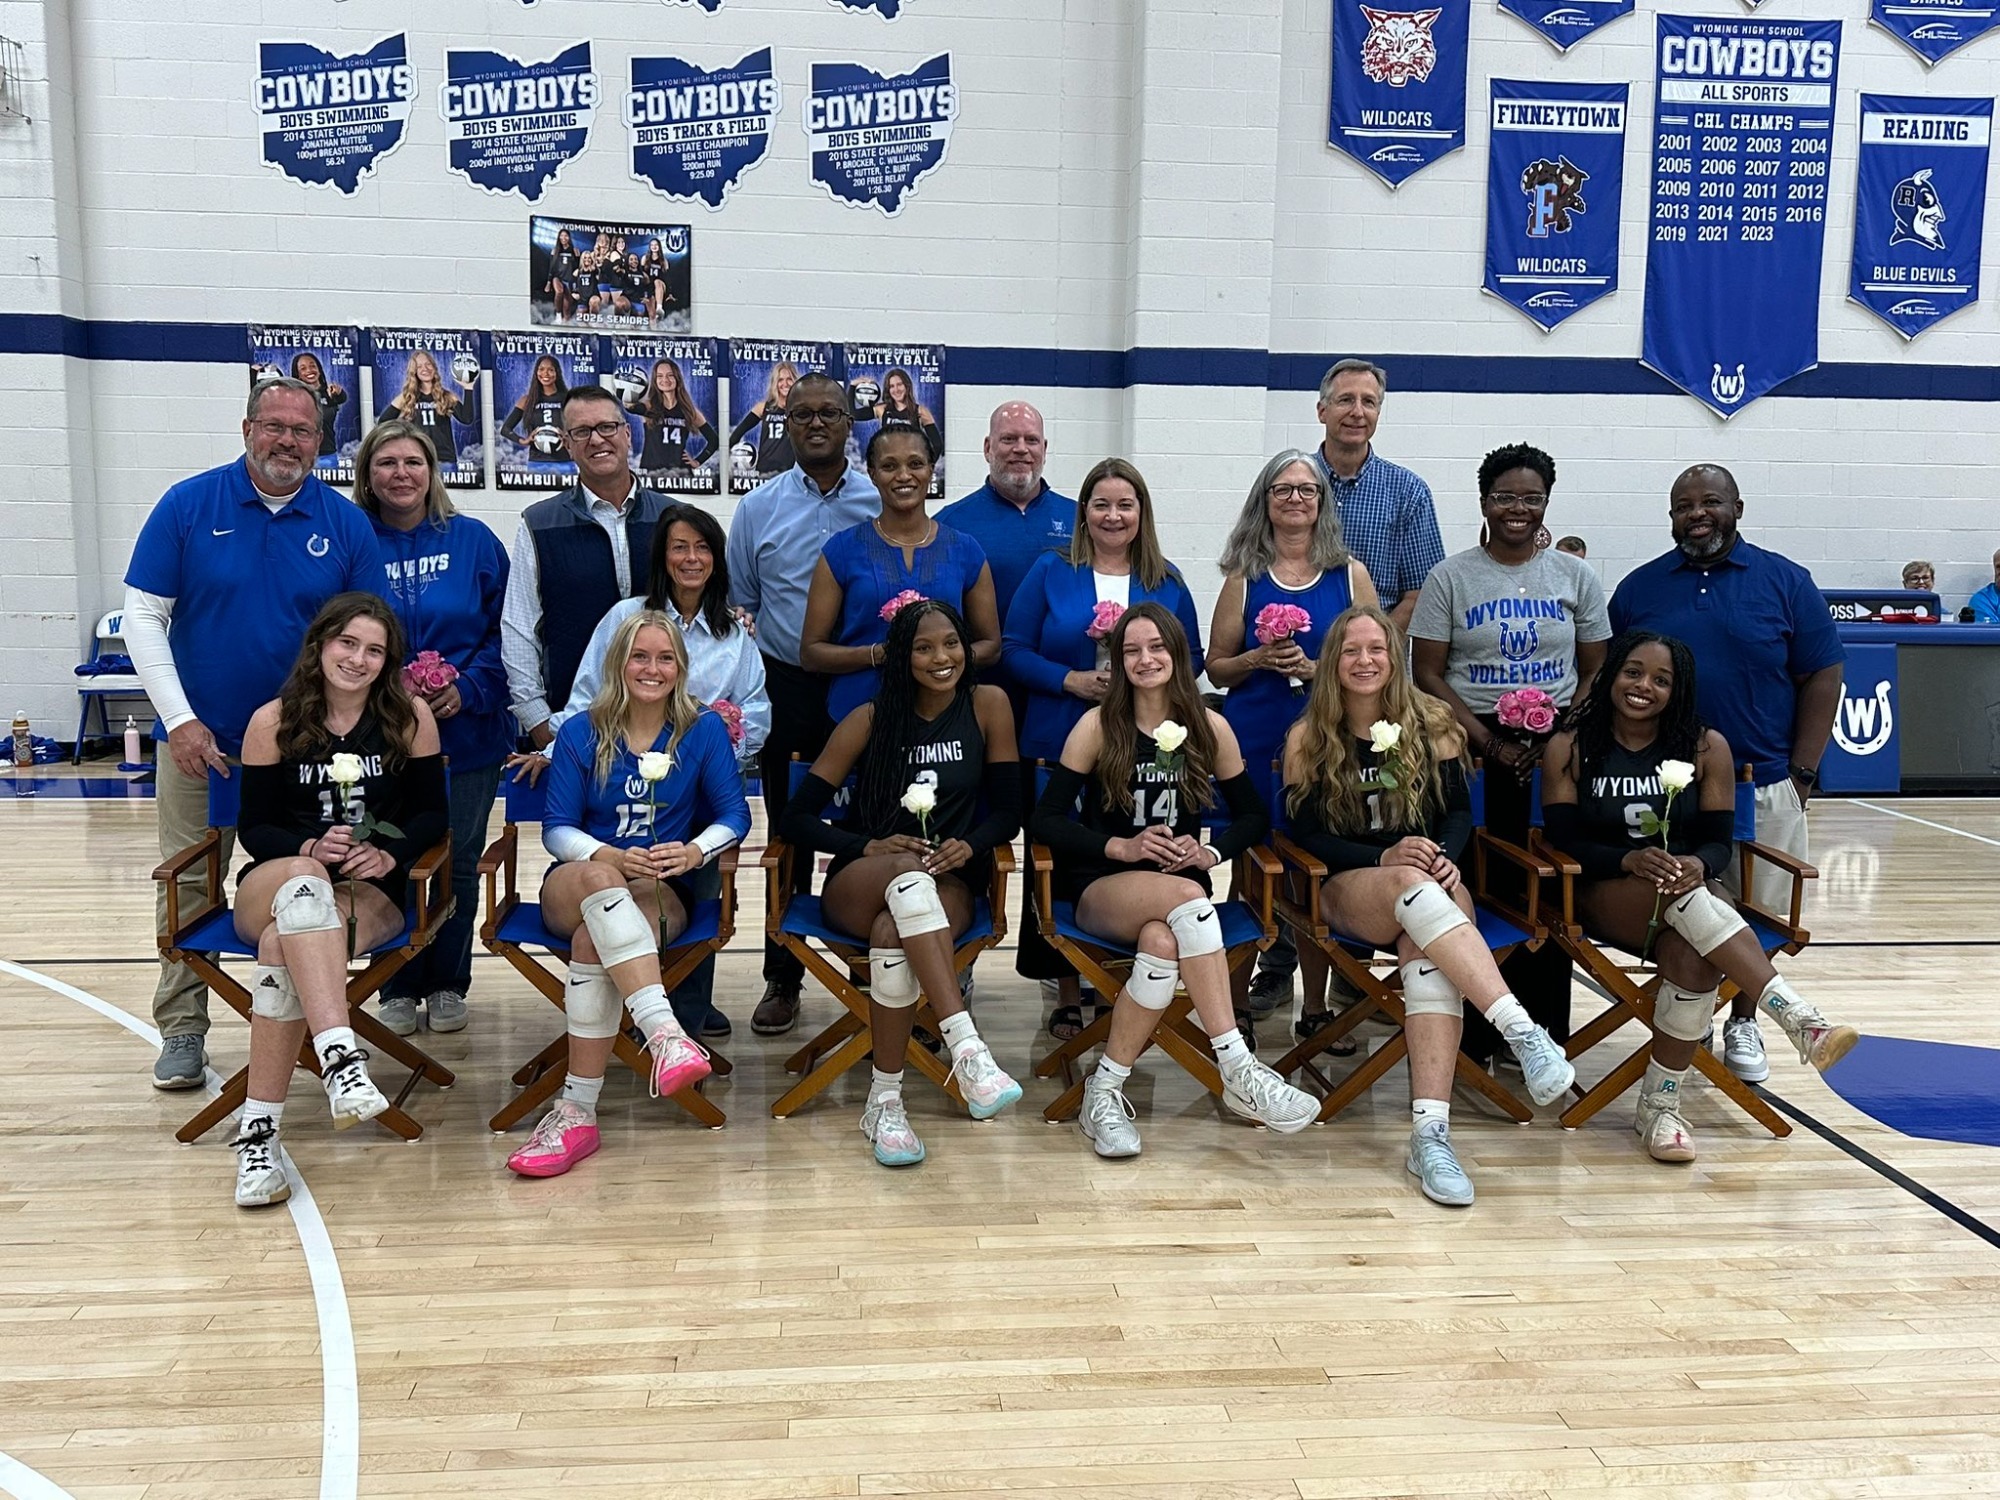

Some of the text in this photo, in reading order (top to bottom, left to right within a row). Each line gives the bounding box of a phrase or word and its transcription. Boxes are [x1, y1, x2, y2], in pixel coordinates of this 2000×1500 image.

[1544, 16, 1569, 25] CHL
[1692, 24, 1805, 36] WYOMING HIGH SCHOOL
[1913, 30, 1939, 39] CHL
[1661, 35, 1834, 78] COWBOYS
[287, 64, 322, 72] WYOMING
[346, 59, 374, 67] SCHOOL
[475, 71, 508, 80] WYOMING
[532, 66, 560, 75] SCHOOL
[255, 64, 414, 110] COWBOYS
[658, 78, 690, 86] WYOMING
[714, 73, 740, 81] SCHOOL
[838, 84, 870, 92] WYOMING
[892, 78, 919, 87] SCHOOL
[442, 73, 599, 118] COWBOYS
[626, 78, 779, 124] COWBOYS
[1701, 84, 1789, 102] ALL SPORTS
[806, 84, 956, 130] COWBOYS
[280, 105, 390, 128] BOYS SWIMMING
[462, 112, 577, 136] BOYS SWIMMING
[1361, 110, 1432, 126] WILDCATS
[1498, 104, 1620, 128] FINNEYTOWN
[1694, 112, 1794, 132] CHL CHAMPS
[283, 123, 384, 142] 2014 STATE CHAMPION
[637, 118, 766, 144] BOYS TRACK & FIELD
[828, 125, 932, 148] BOYS SWIMMING
[1882, 118, 1968, 140] READING
[302, 135, 368, 150] JONATHAN RUTTER
[472, 131, 567, 149] 2014 STATE CHAMPION
[652, 137, 749, 155] 2015 STATE CHAMPION
[1658, 134, 1827, 154] 2001 2002 2003 2004
[296, 144, 374, 161] 100yd BREASTSTROKE
[483, 142, 556, 158] JONATHAN RUTTER
[682, 150, 721, 161] BEN STITES
[828, 142, 929, 161] 2016 STATE CHAMPIONS
[1373, 152, 1398, 162] CHL
[326, 156, 346, 166] 56.24
[468, 150, 571, 169] 200yd INDIVIDUAL MEDLEY
[682, 159, 722, 171] 3200m RUN
[836, 154, 922, 170] P. BROCKER, C. WILLIAMS,
[1658, 157, 1826, 177] 2005 2006 2007 2008
[846, 164, 911, 178] C. RUTTER, C. BURT
[852, 174, 906, 187] 200 FREE RELAY
[1656, 180, 1824, 200] 2009 2010 2011 2012
[1898, 185, 1916, 207] R
[1532, 183, 1558, 234] F
[1656, 203, 1822, 222] 2013 2014 2015 2016
[556, 222, 662, 236] WYOMING VOLLEYBALL
[1655, 226, 1774, 242] 2019 2021 2023
[1517, 258, 1586, 273] WILDCATS
[1872, 266, 1956, 282] BLUE DEVILS
[1528, 296, 1553, 307] CHL
[1892, 306, 1916, 315] CHL
[576, 313, 650, 326] 2026 SENIORS
[252, 336, 352, 348] VOLLEYBALL
[264, 329, 340, 339] WYOMING COWBOYS
[386, 331, 462, 342] WYOMING COWBOYS
[507, 335, 582, 346] WYOMING COWBOYS
[374, 338, 473, 352] VOLLEYBALL
[496, 342, 593, 356] VOLLEYBALL
[616, 346, 711, 360] VOLLEYBALL
[626, 340, 701, 350] WYOMING COWBOYS
[744, 343, 816, 354] WYOMING COWBOYS
[858, 347, 929, 358] WYOMING COWBOYS
[733, 350, 826, 364] VOLLEYBALL
[848, 354, 939, 368] VOLLEYBALL
[422, 410, 436, 426] 11
[543, 410, 552, 423] 2
[662, 427, 681, 444] 14
[768, 423, 784, 438] 12
[501, 473, 556, 486] WAMBUI
[658, 477, 713, 490] GALINGER
[108, 615, 124, 636] W
[1468, 658, 1564, 684] VOLLEYBALL
[318, 786, 365, 823] 15
[1133, 789, 1178, 827] 14
[616, 804, 656, 838] 12
